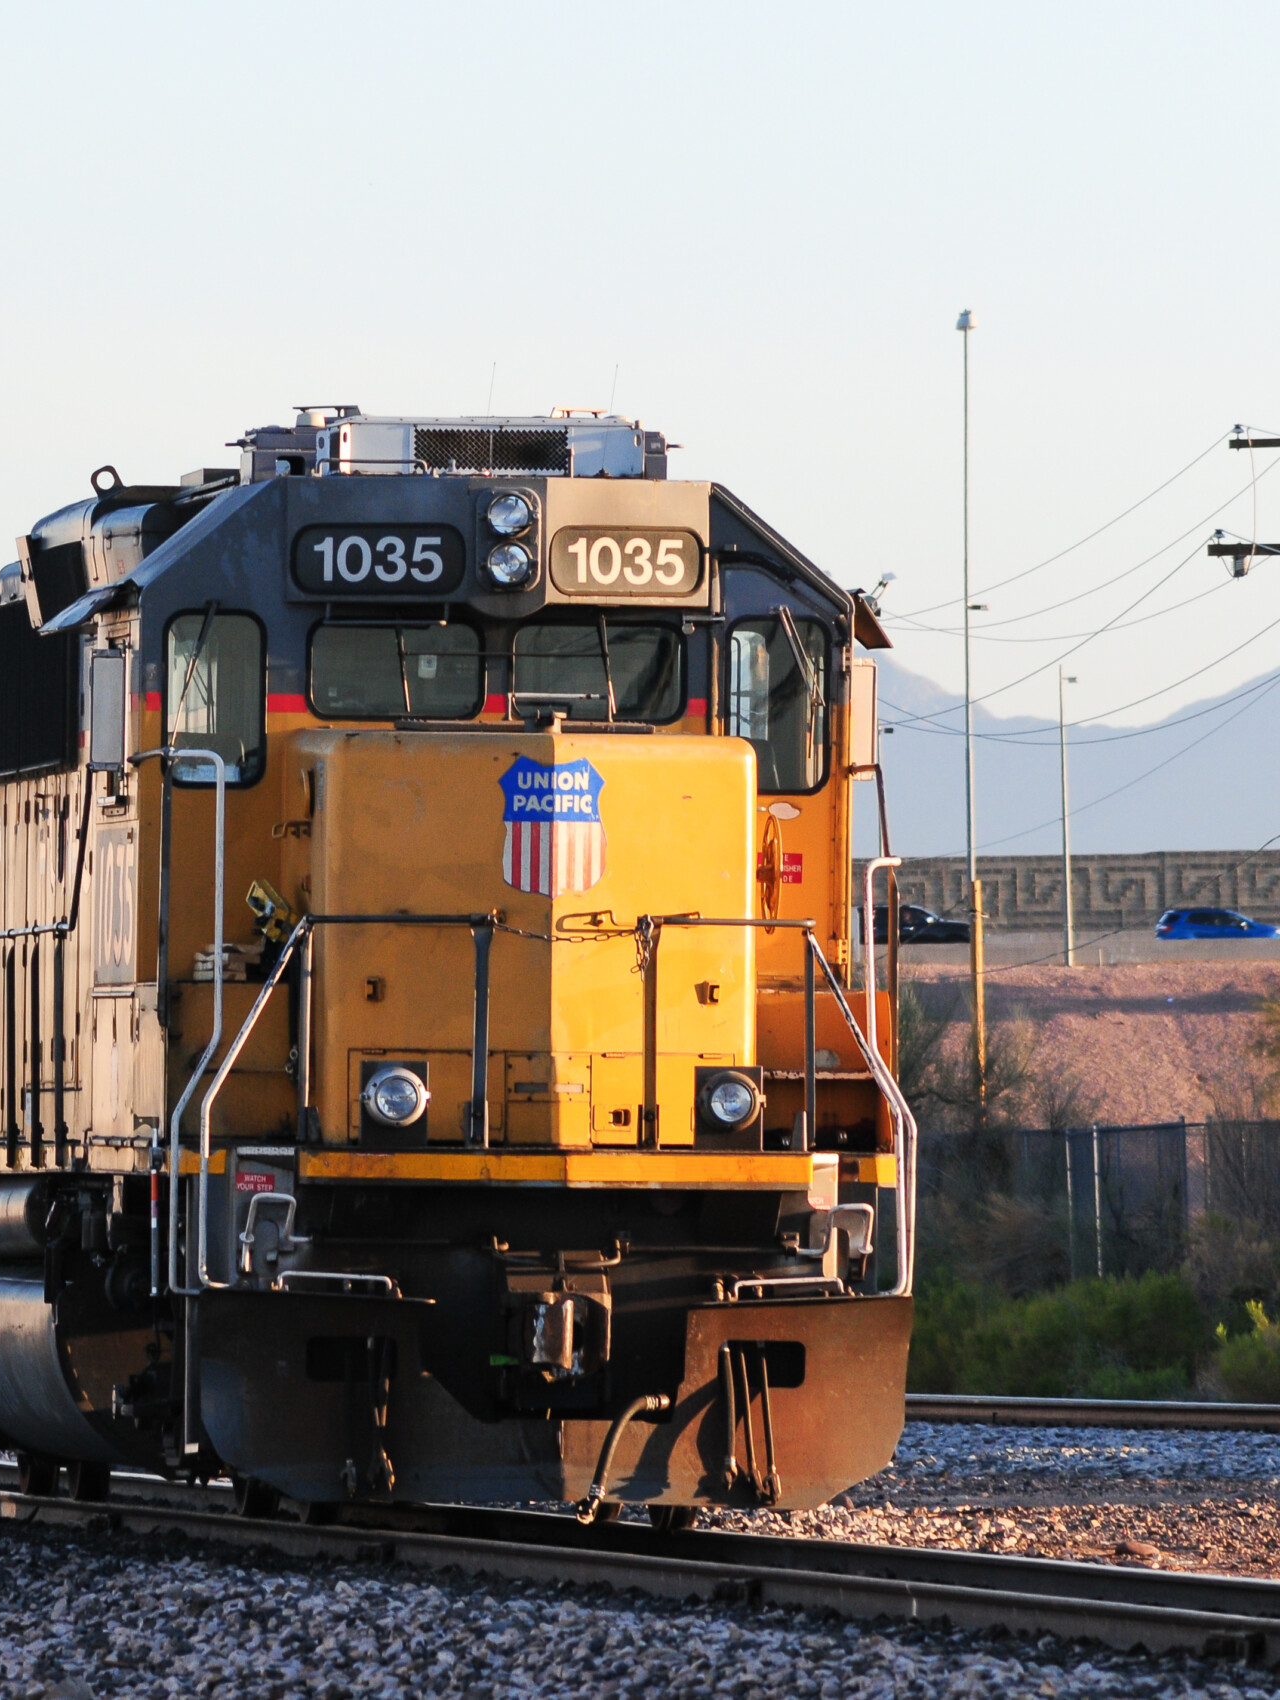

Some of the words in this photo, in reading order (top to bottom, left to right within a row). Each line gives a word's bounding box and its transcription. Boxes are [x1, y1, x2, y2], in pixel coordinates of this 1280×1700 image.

[314, 536, 443, 583] 1035
[568, 537, 685, 585] 1035
[517, 771, 589, 791] UNION
[513, 794, 592, 814] PACIFIC
[98, 841, 134, 966] 1035
[236, 1183, 254, 1191] YOUR
[256, 1183, 274, 1192] STEP
[244, 1174, 267, 1183] WATCH
